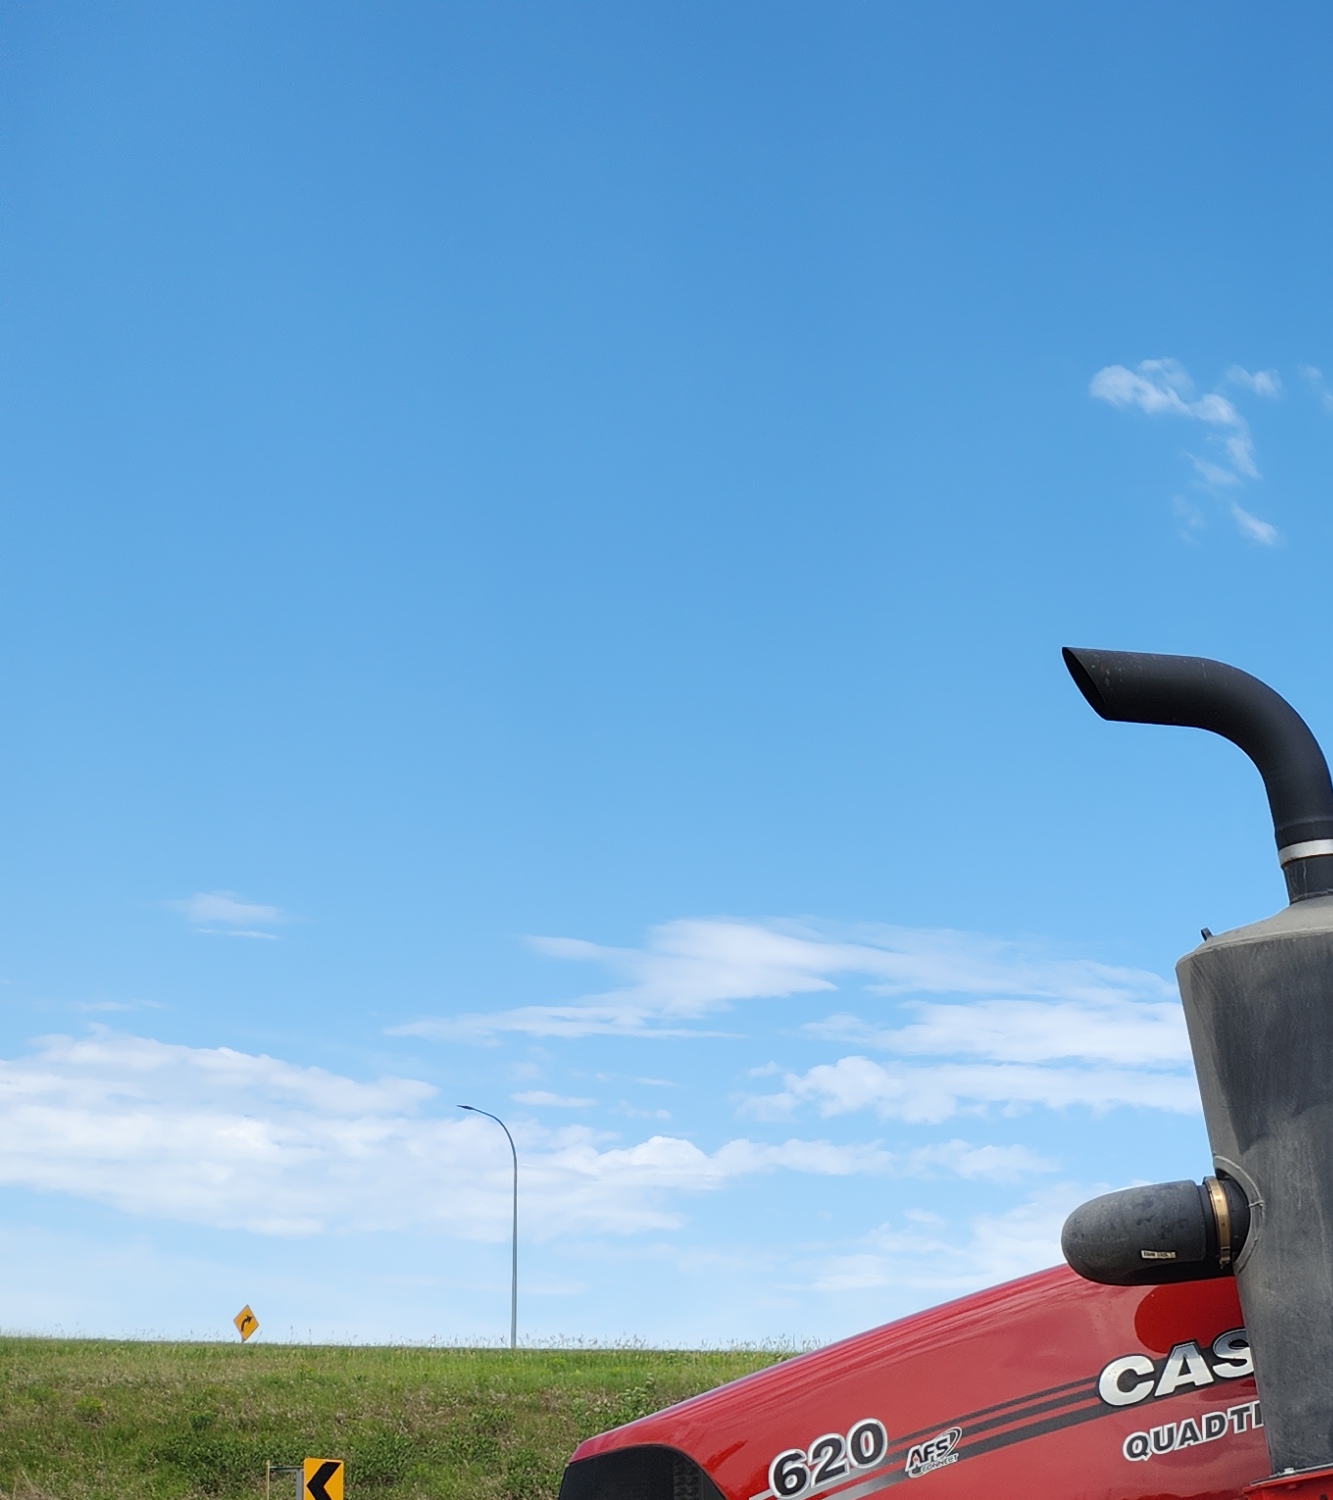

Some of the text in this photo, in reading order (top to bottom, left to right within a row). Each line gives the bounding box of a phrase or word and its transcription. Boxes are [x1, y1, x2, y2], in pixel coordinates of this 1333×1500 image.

[769, 1418, 888, 1499] 620
[906, 1436, 950, 1470] AFS
[920, 1452, 959, 1474] CONNECT
